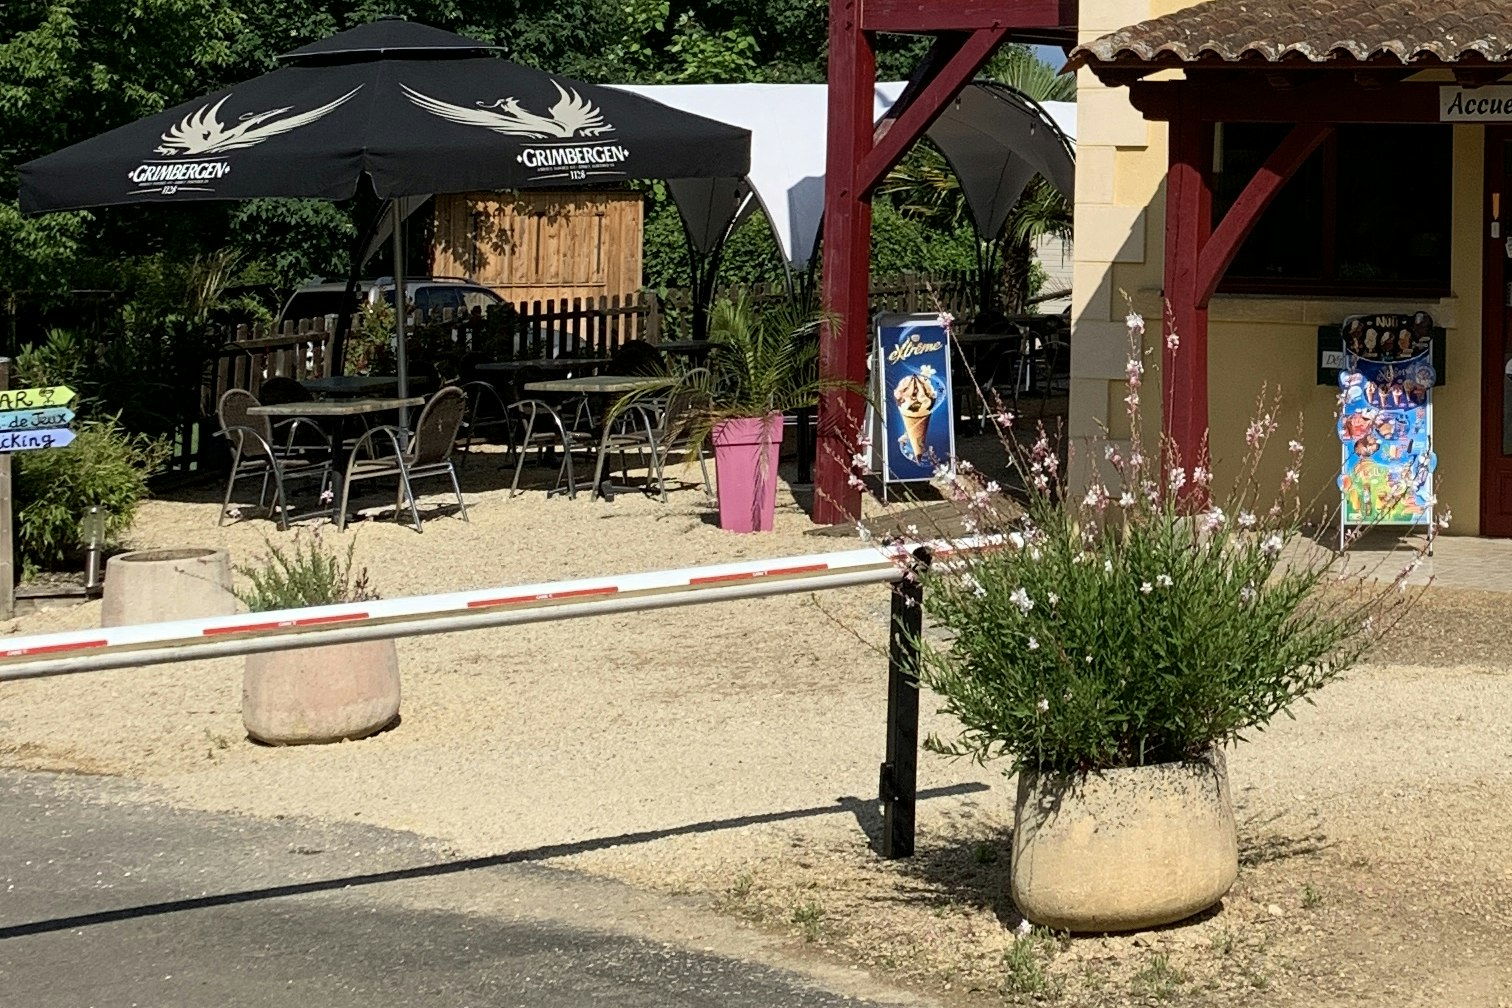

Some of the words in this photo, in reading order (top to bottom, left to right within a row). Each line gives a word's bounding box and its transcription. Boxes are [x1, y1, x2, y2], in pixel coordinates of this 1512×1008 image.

[523, 146, 625, 167] GRIMBERGEN
[132, 162, 228, 182] GRIMBERGEN
[8, 415, 28, 428] de
[31, 411, 67, 426] Jeux
